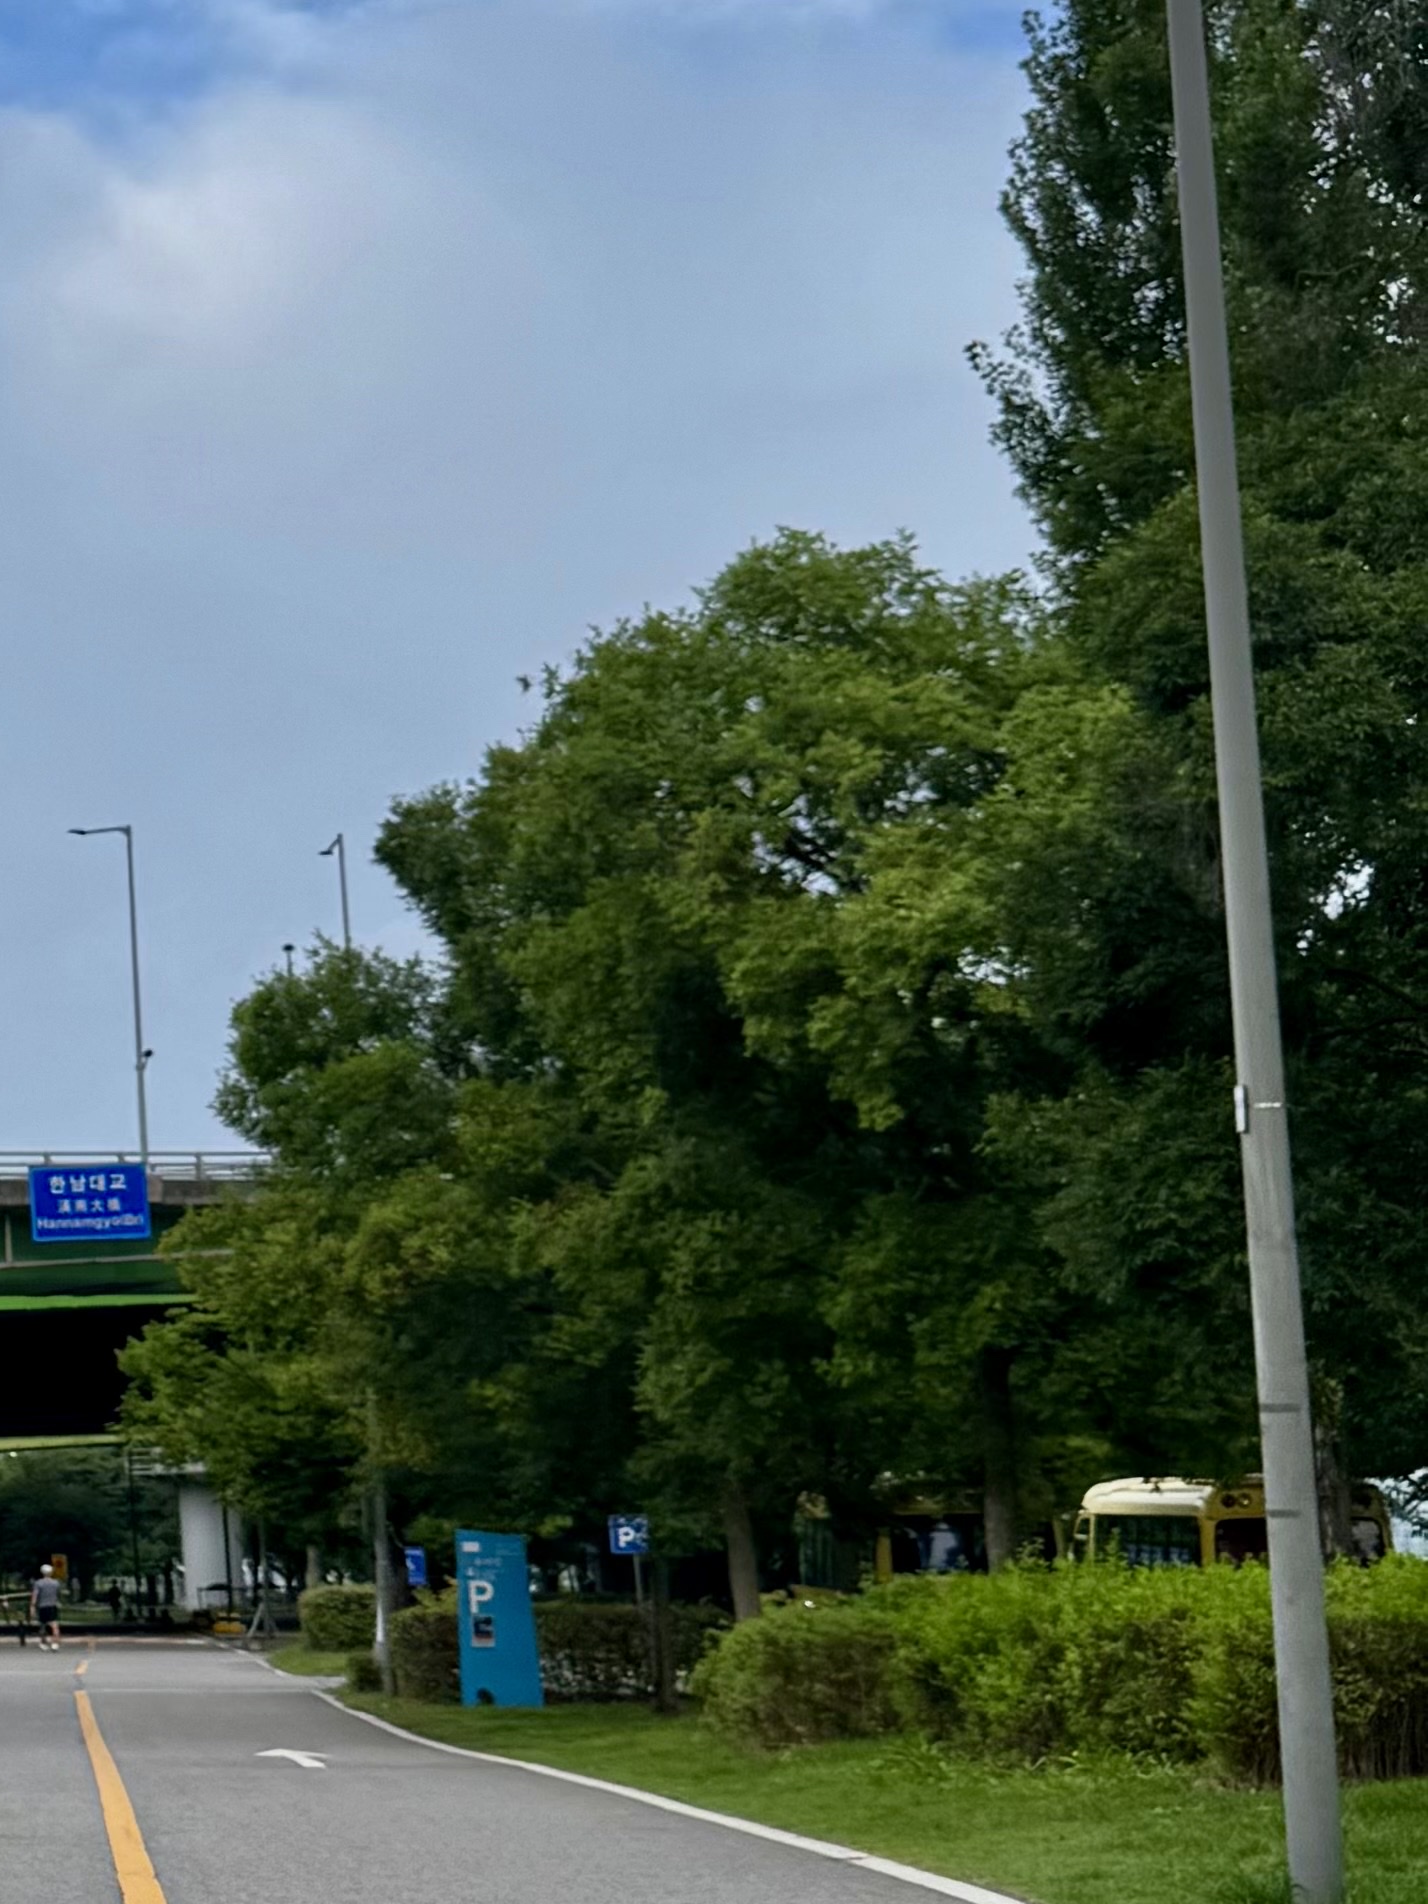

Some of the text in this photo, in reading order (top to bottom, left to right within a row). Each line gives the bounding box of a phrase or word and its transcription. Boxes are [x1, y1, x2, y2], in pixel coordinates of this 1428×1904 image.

[50, 1174, 126, 1194] 한남대교
[618, 1526, 635, 1548] P
[468, 1580, 494, 1613] P
